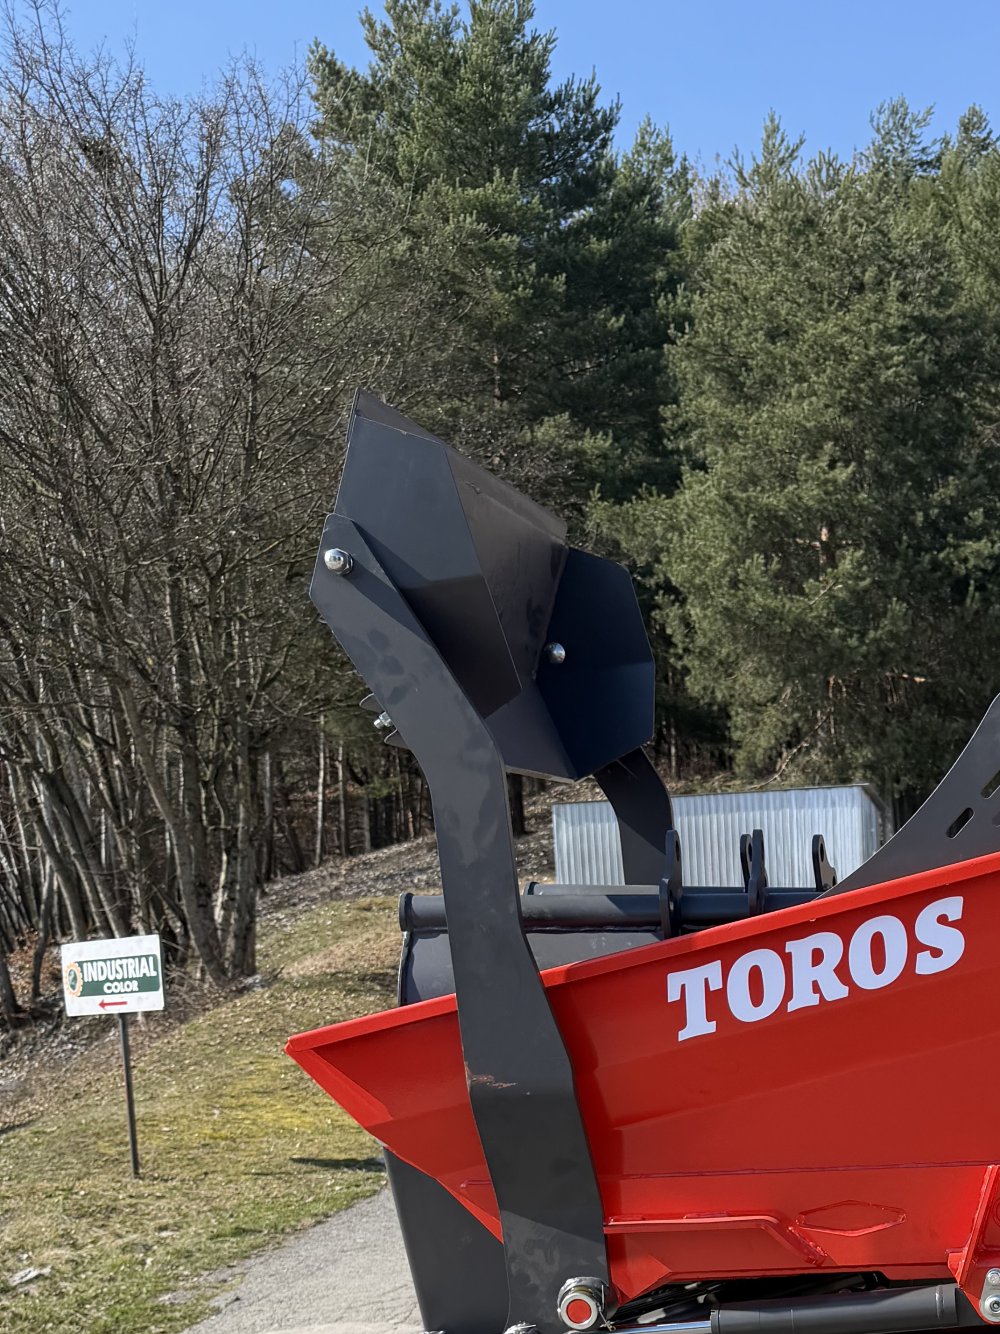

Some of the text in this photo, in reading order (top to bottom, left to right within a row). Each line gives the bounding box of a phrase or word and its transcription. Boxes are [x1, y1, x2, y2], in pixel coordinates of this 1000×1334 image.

[83, 956, 157, 982] INDUSTRIAL
[667, 896, 965, 1041] TOROS
[103, 980, 138, 994] COLOR
